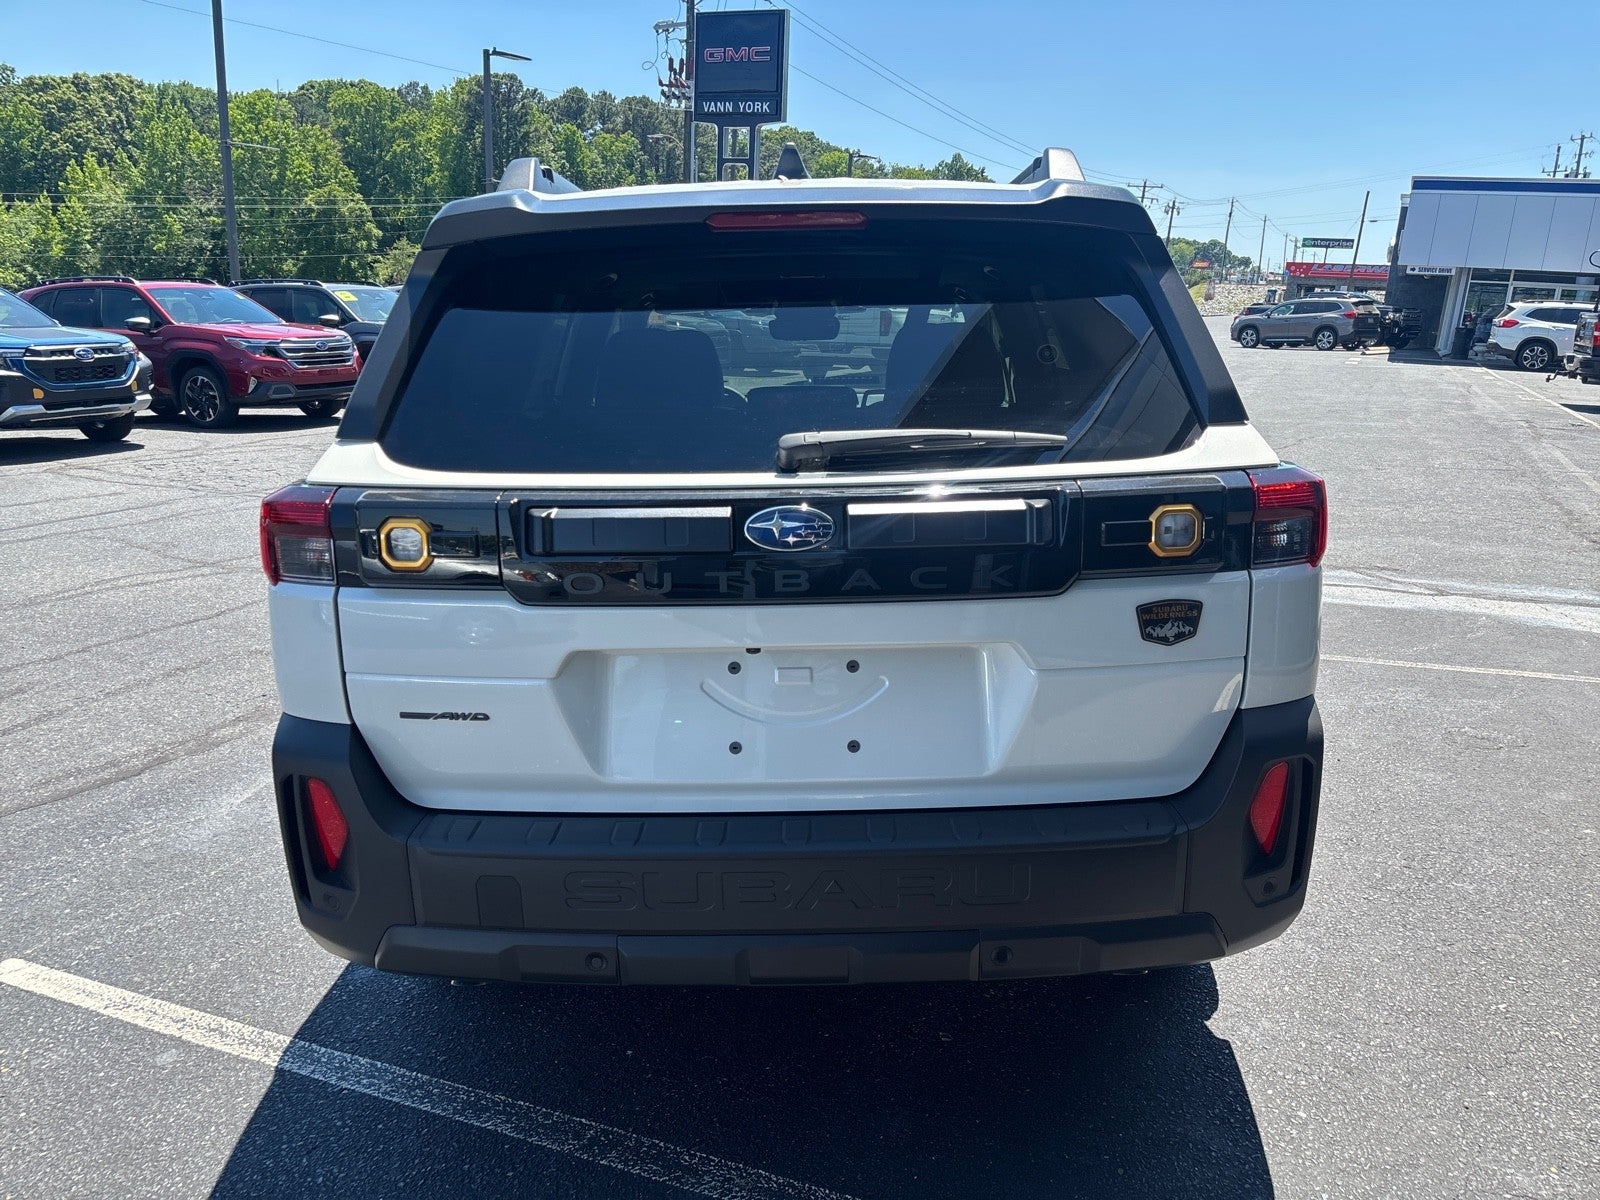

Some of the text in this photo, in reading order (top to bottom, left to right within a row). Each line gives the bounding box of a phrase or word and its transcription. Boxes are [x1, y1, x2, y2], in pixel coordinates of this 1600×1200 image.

[704, 46, 771, 63] GMC
[703, 101, 770, 113] VANN YORK
[1303, 239, 1353, 248] enterprise
[1417, 266, 1438, 274] SERVICE
[562, 564, 1014, 595] OUTBACK
[1152, 604, 1188, 613] SUBARU
[1142, 610, 1198, 619] WILDERNESS
[432, 711, 490, 721] AWD
[563, 864, 1032, 912] SUBARU
